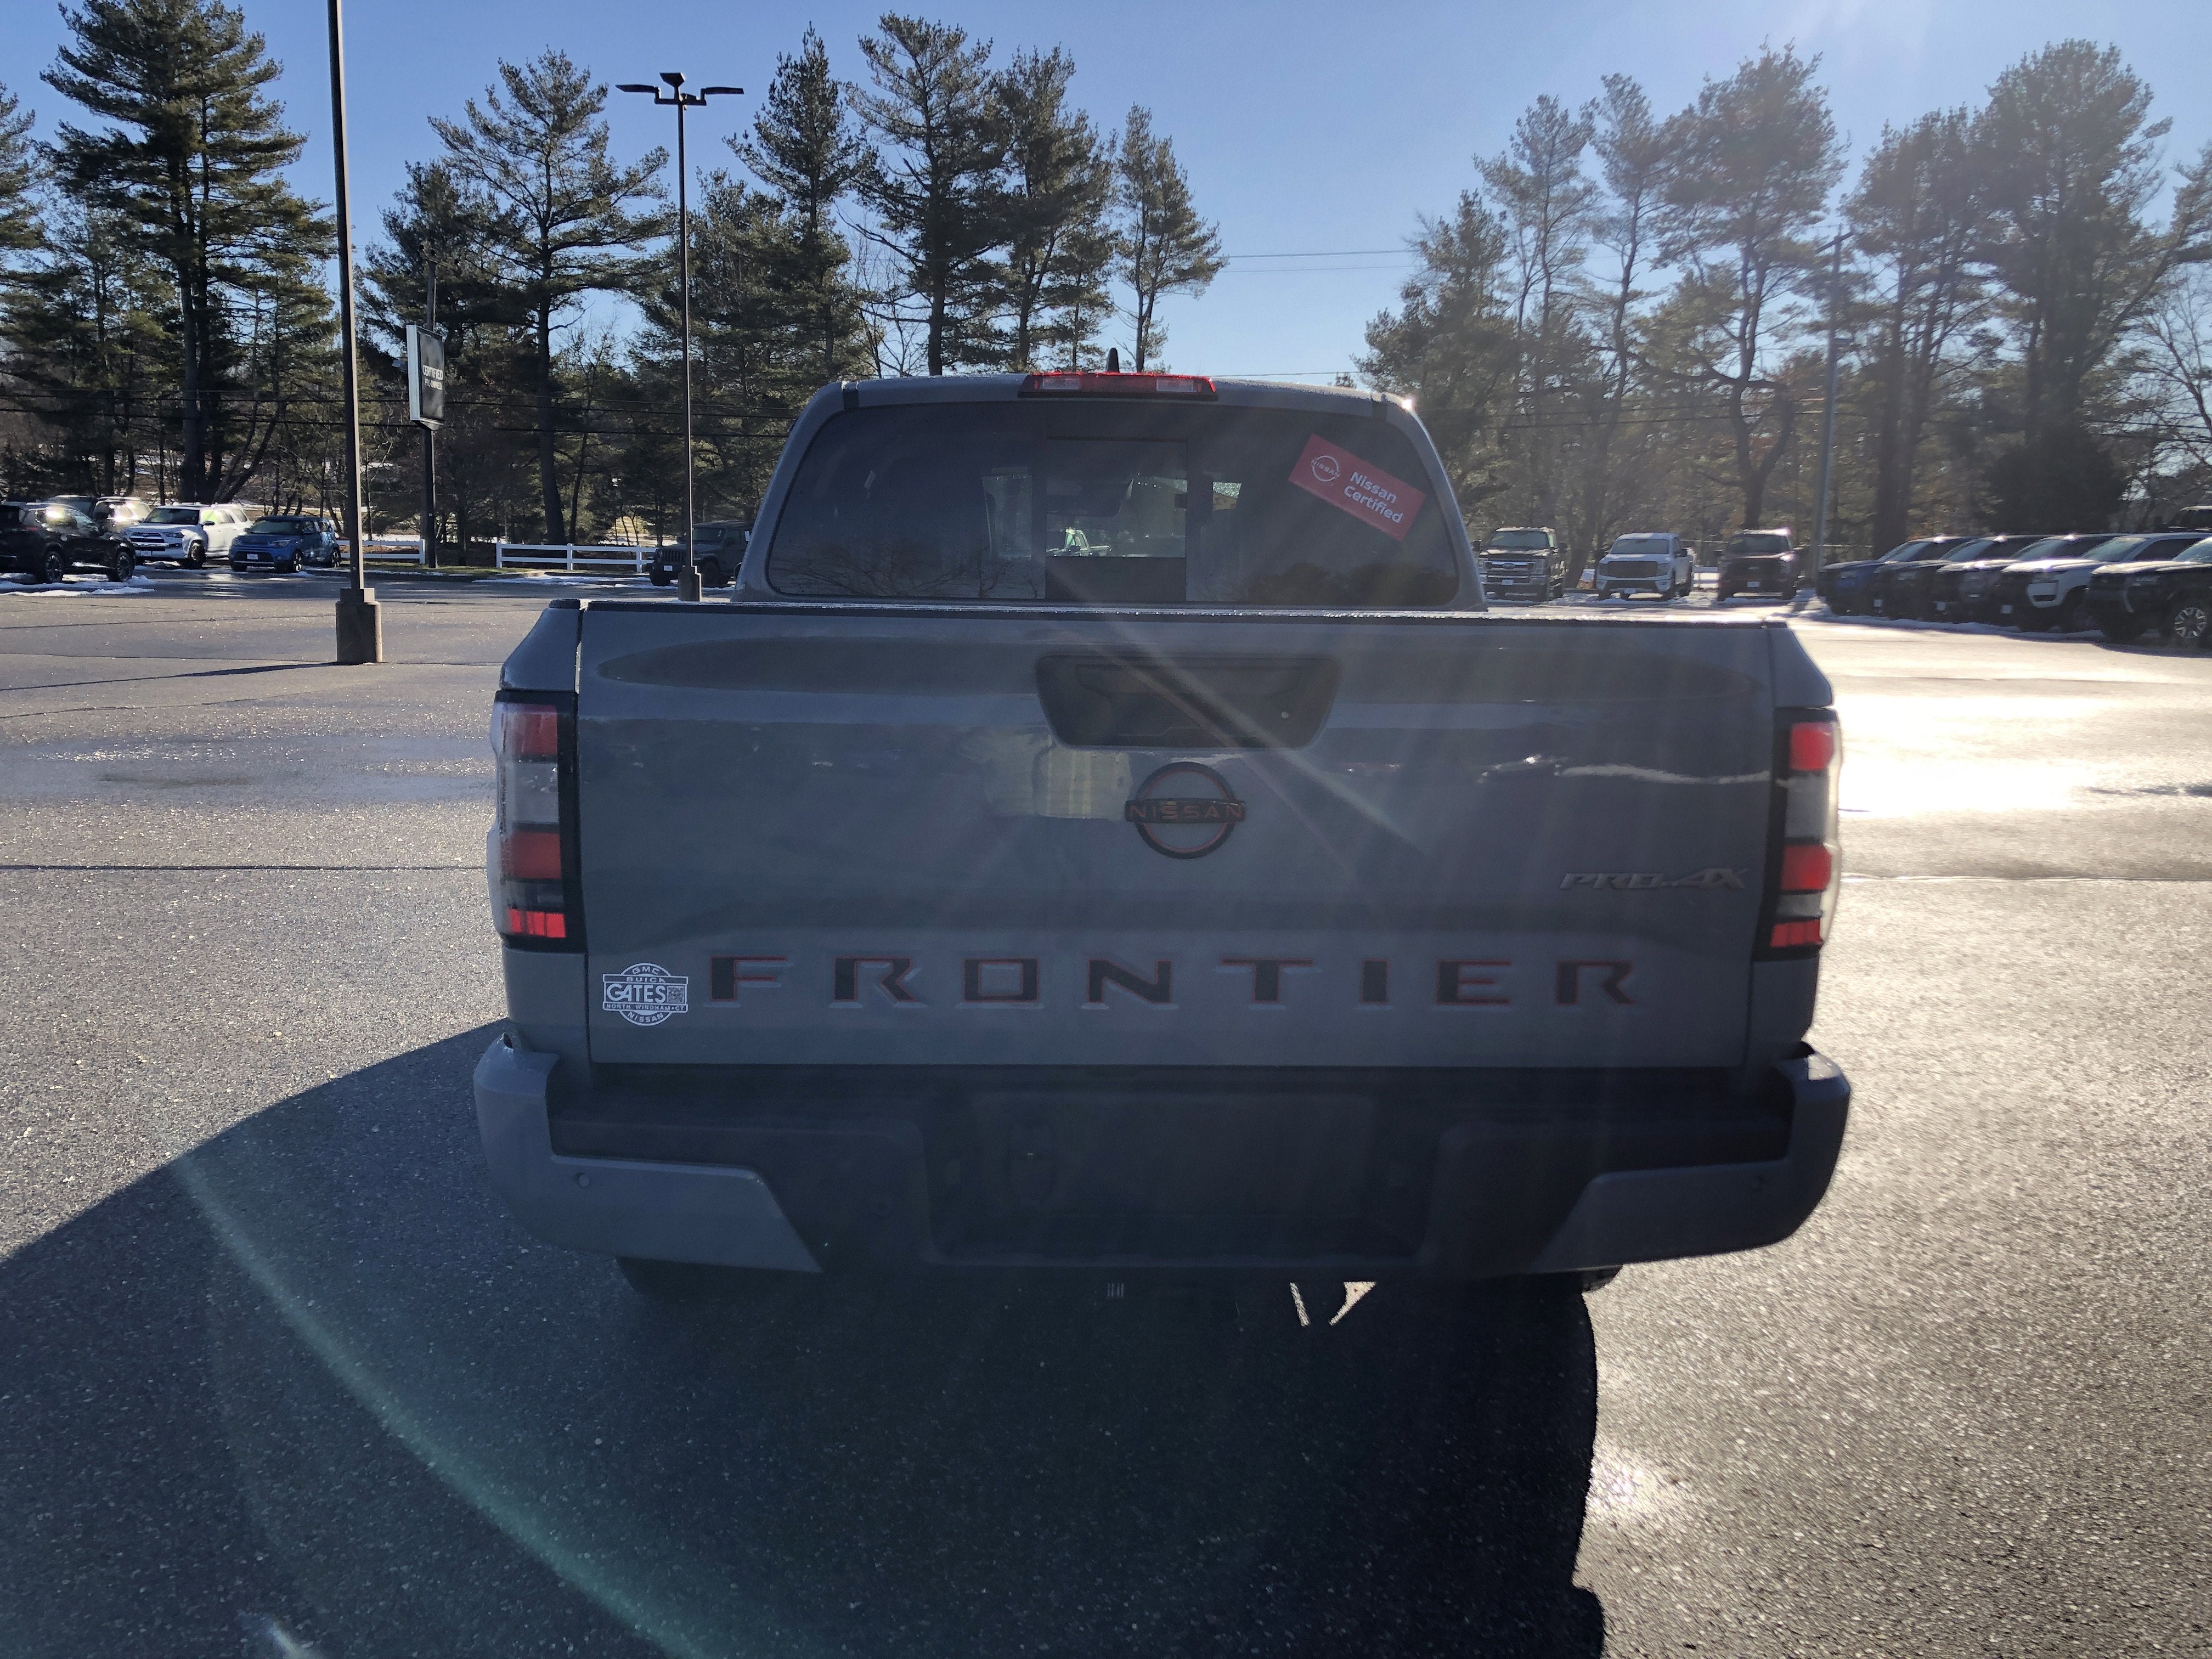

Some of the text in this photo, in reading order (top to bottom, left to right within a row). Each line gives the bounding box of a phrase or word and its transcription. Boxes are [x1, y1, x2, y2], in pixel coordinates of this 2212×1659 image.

[1311, 460, 1340, 478] NISSAN
[1350, 471, 1397, 504] Nissan
[1344, 486, 1404, 523] Certified
[1128, 804, 1243, 820] NISSAN
[632, 966, 659, 975] GMC
[709, 956, 1636, 1006] FRONTIER
[607, 984, 666, 1003] GATES
[627, 1012, 664, 1023] NISSAN
